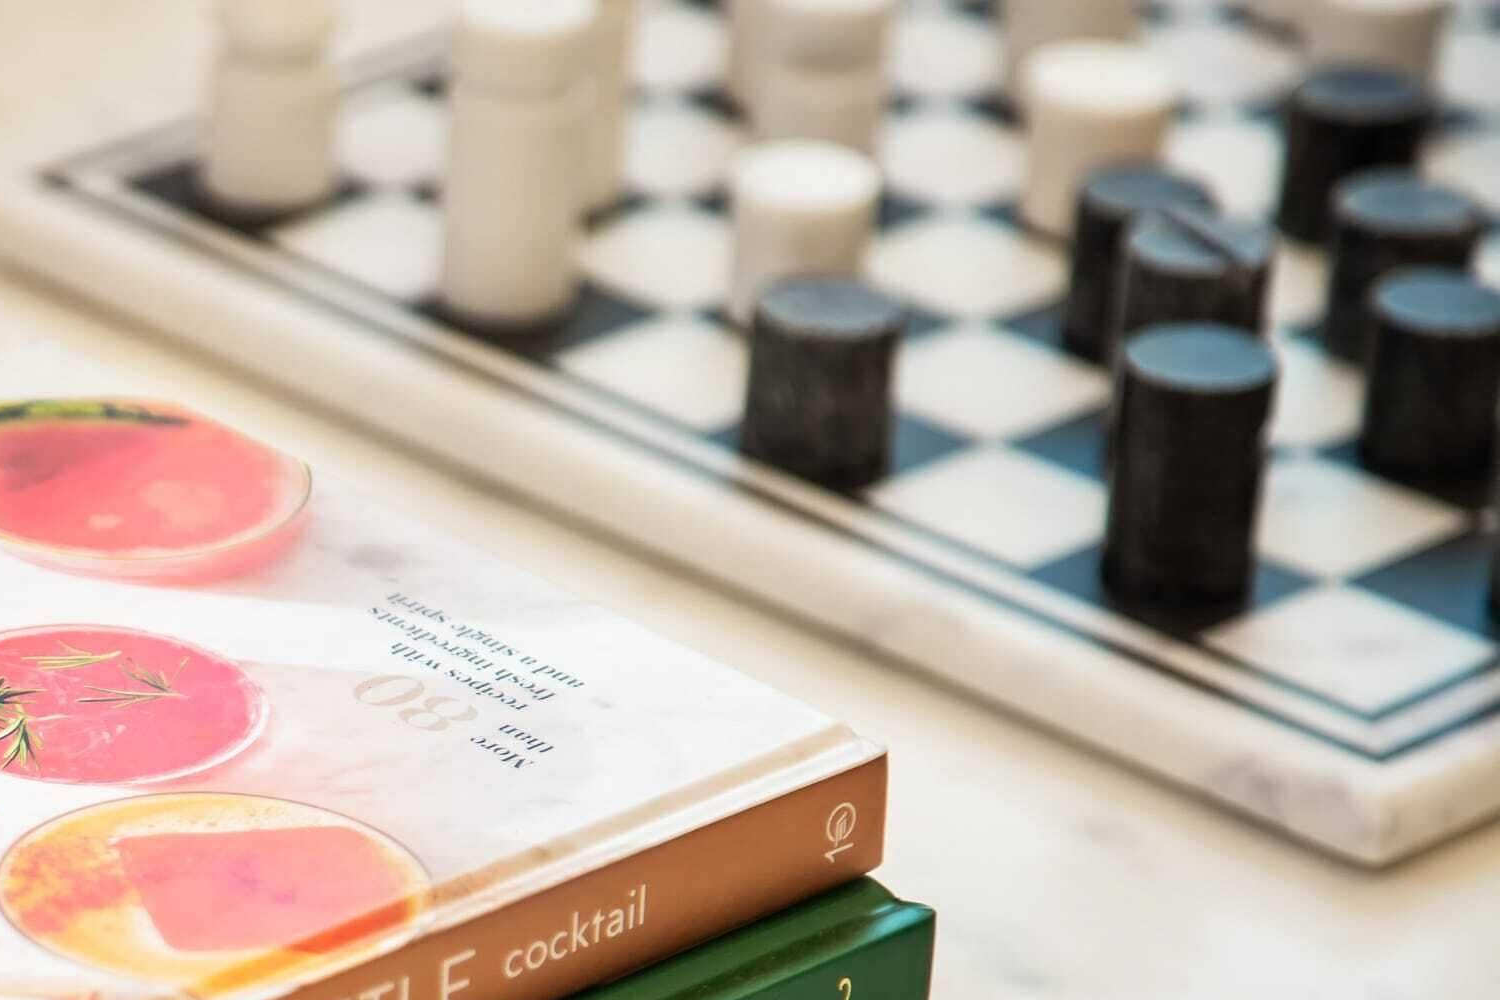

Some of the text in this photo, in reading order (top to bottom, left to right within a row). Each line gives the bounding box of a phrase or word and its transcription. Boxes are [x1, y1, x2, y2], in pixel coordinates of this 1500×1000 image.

[368, 606, 557, 701] fresh ingredients
[386, 591, 585, 688] and a single spirit
[354, 675, 478, 731] 80
[390, 642, 529, 711] recipes with
[469, 735, 535, 769] More
[498, 724, 555, 754] than
[503, 885, 648, 979] cocktail
